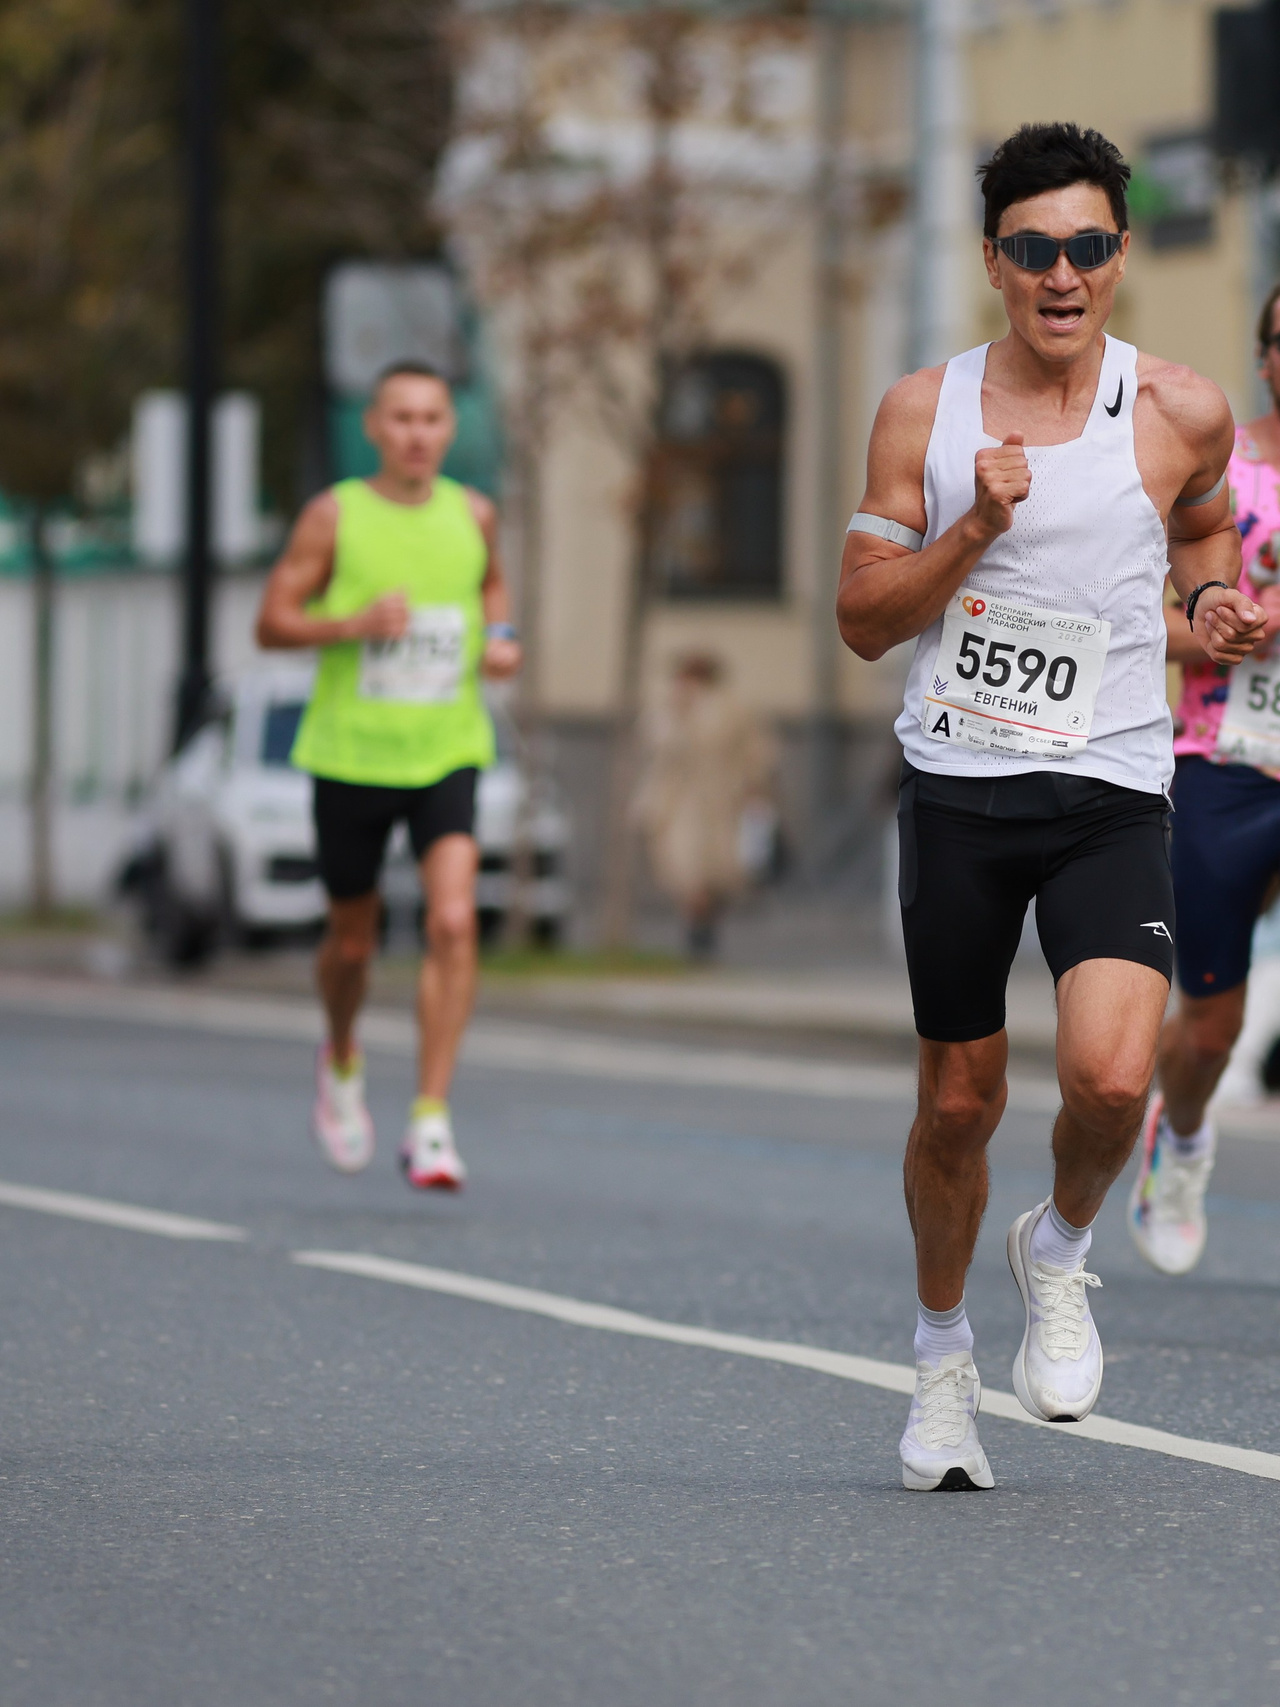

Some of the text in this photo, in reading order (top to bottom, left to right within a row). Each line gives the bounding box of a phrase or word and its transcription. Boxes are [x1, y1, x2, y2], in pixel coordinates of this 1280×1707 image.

[990, 602, 1033, 618] СБЕРПРАЙМ
[986, 616, 1030, 632] МАРАФОН
[988, 609, 1046, 628] МОСКОВСКИЙ
[1055, 620, 1076, 630] 42,2
[955, 631, 1078, 702] 5590
[974, 691, 1039, 716] ЕВГЕНИЙ
[1072, 716, 1080, 725] 2
